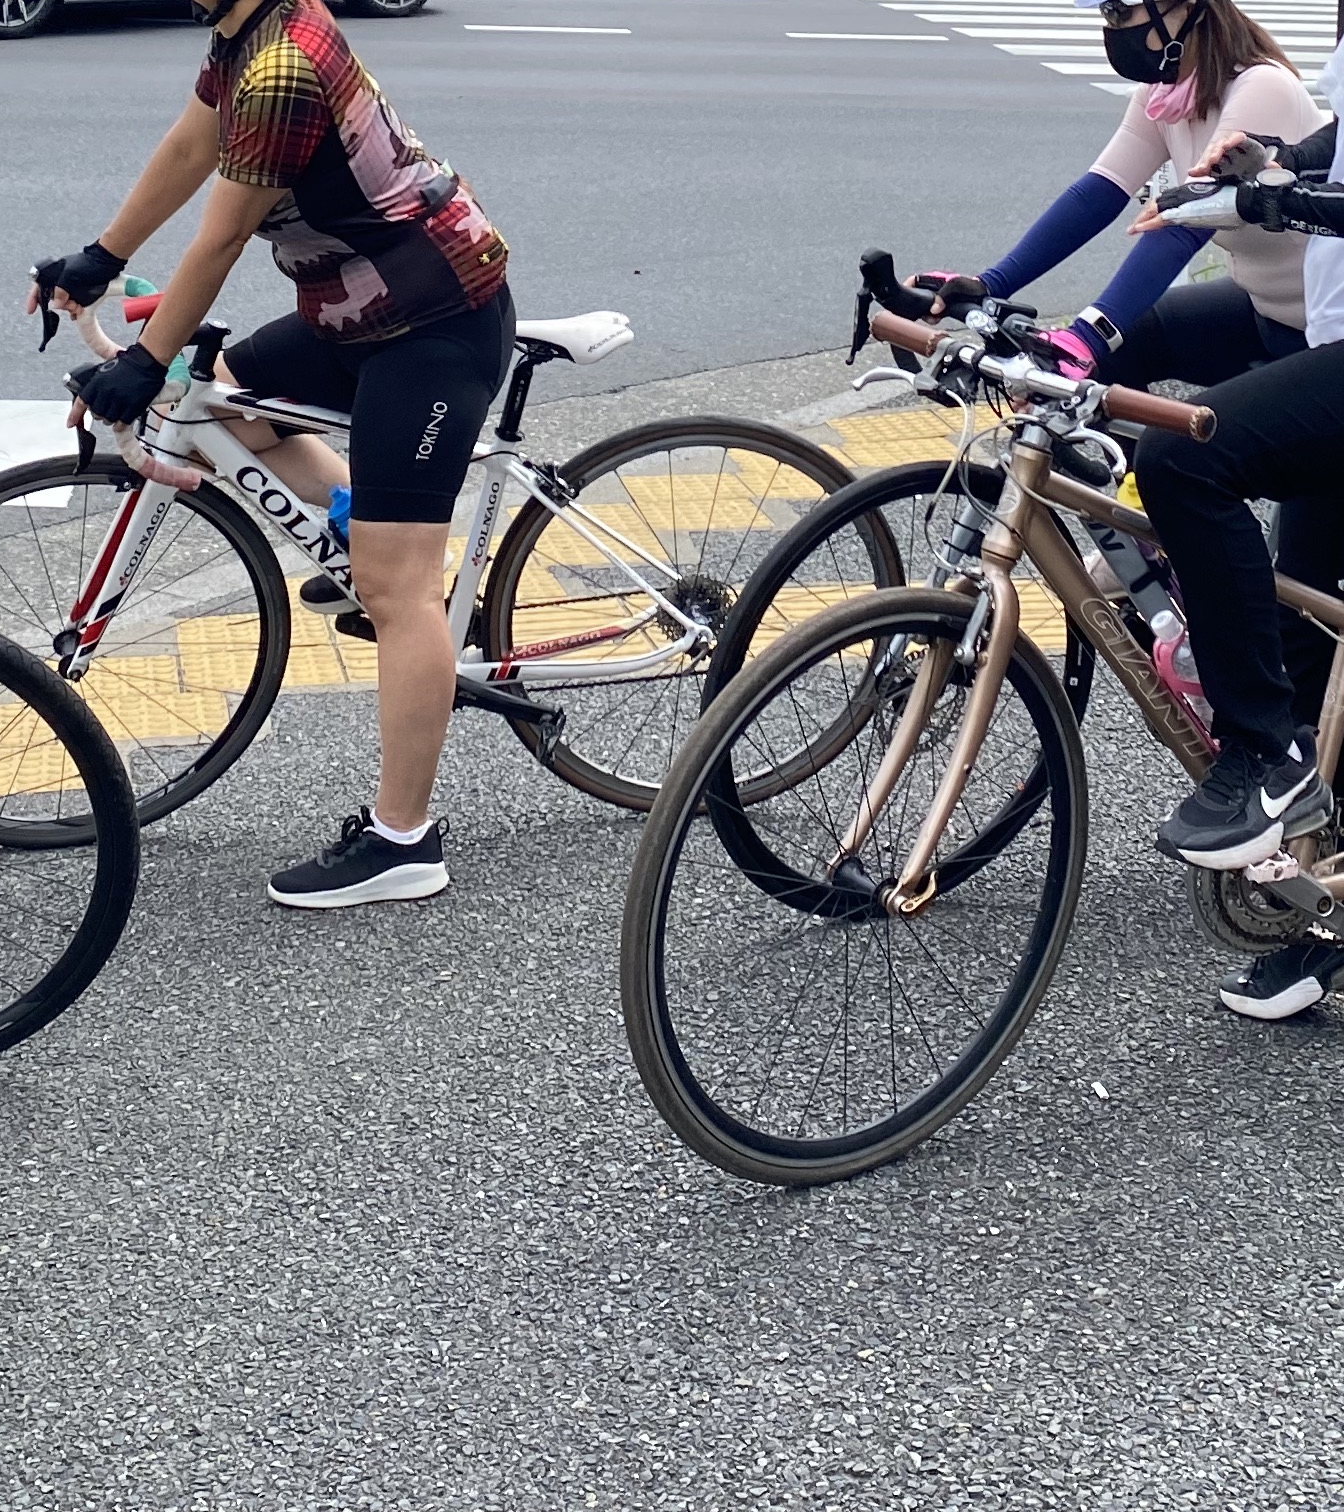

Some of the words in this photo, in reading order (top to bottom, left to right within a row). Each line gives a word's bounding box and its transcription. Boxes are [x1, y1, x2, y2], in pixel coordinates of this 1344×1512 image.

[415, 401, 448, 461] TOKINO
[123, 501, 166, 578] COLNAGO
[474, 481, 500, 558] COLNAGO
